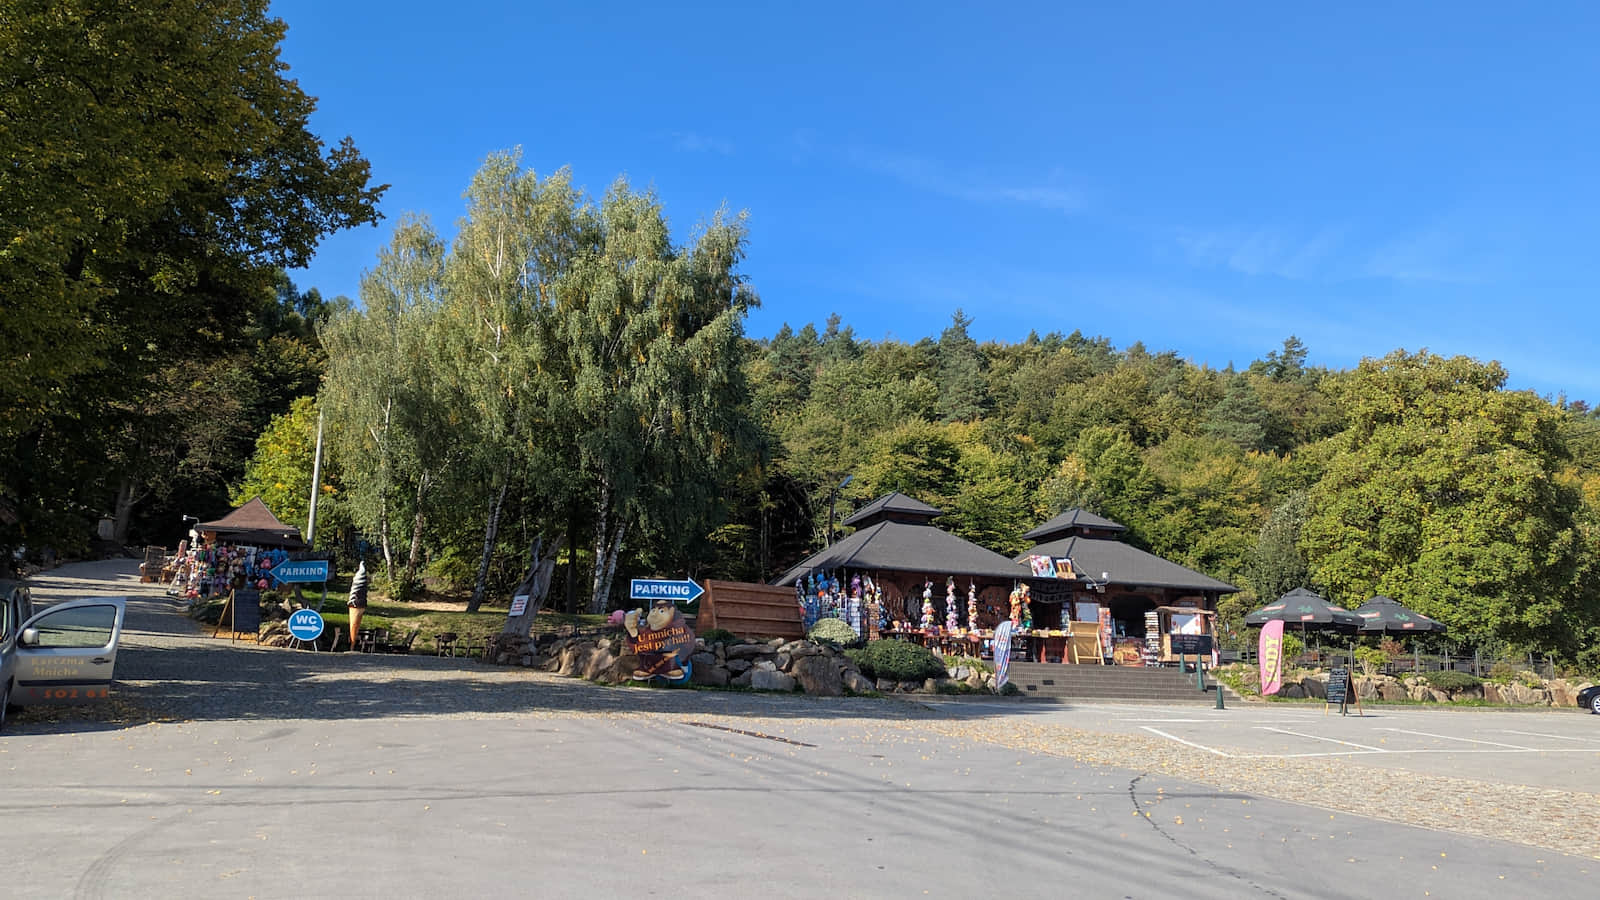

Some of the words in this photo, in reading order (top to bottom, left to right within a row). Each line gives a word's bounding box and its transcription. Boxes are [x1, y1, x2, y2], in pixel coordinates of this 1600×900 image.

[280, 567, 323, 576] PARKING
[634, 584, 690, 595] PARKING
[296, 615, 317, 625] WC
[638, 633, 646, 643] U
[648, 627, 684, 640] mnicha
